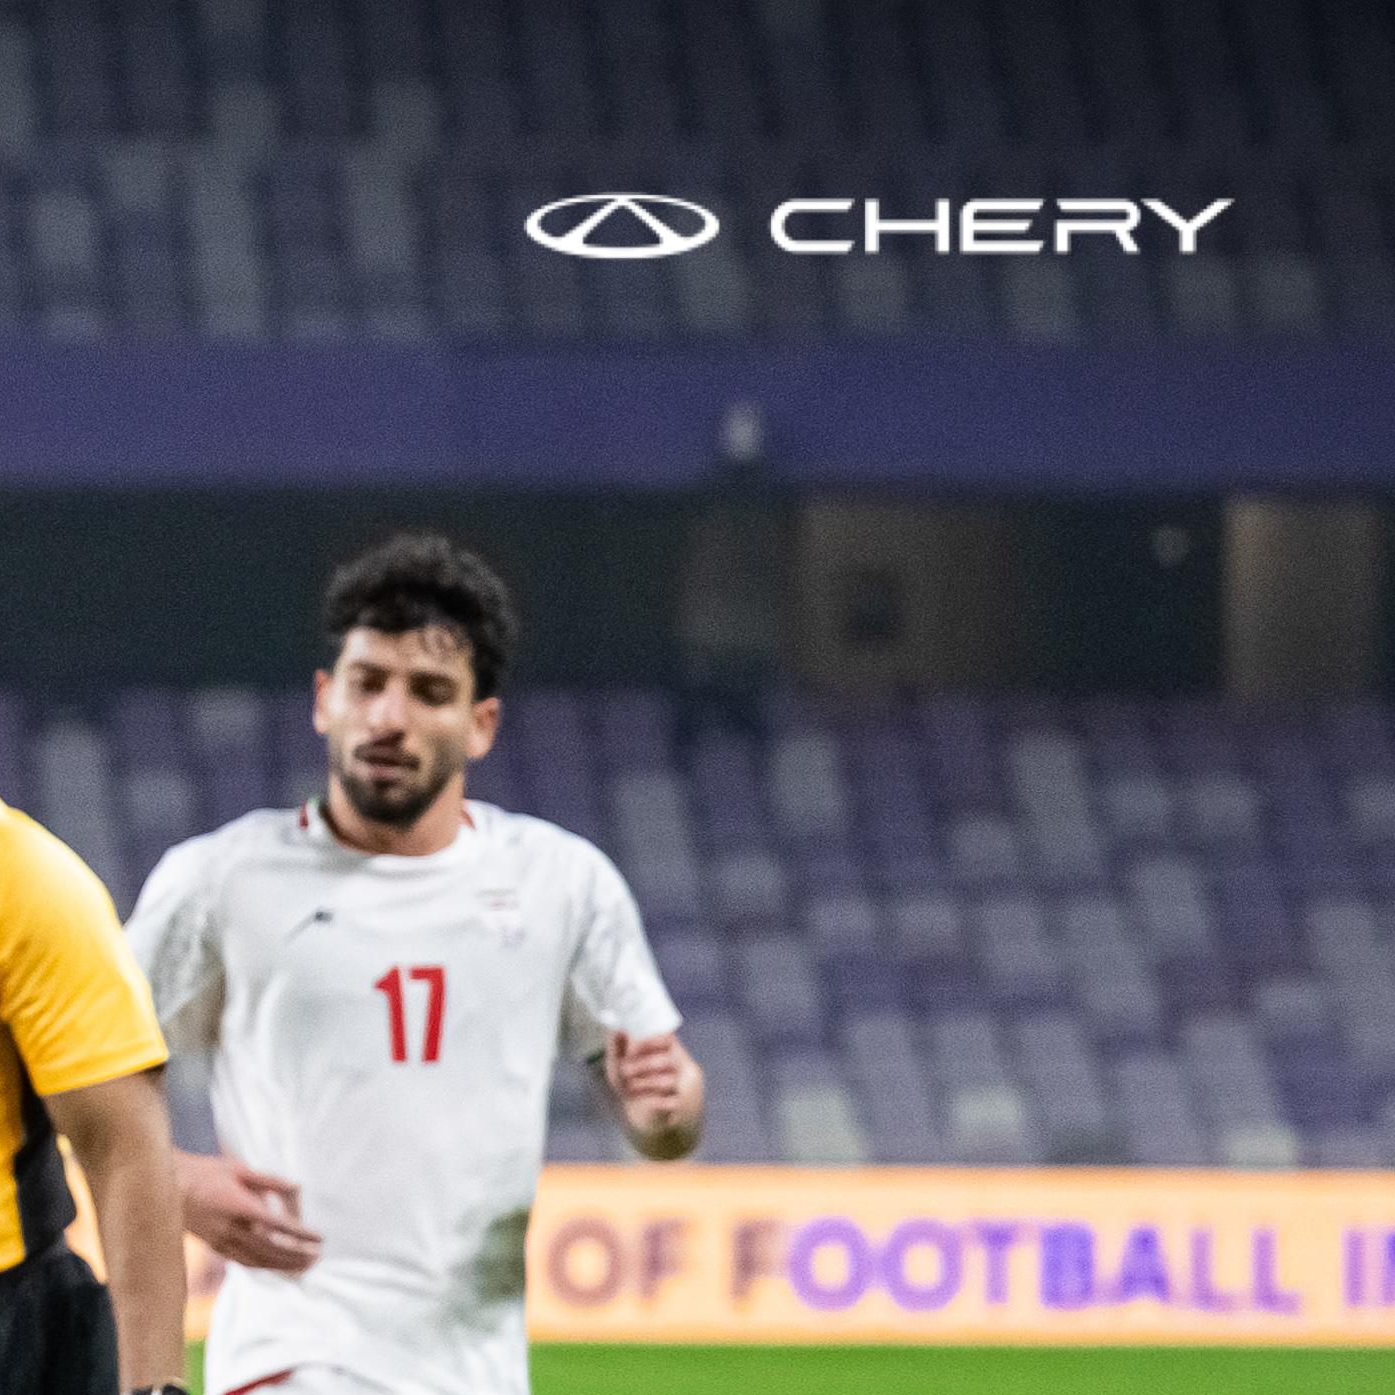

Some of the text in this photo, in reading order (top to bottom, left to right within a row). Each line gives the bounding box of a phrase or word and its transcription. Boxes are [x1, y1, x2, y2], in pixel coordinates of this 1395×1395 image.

[374, 965, 446, 1064] 17
[546, 1217, 1395, 1314] OF FOOTBALL I
